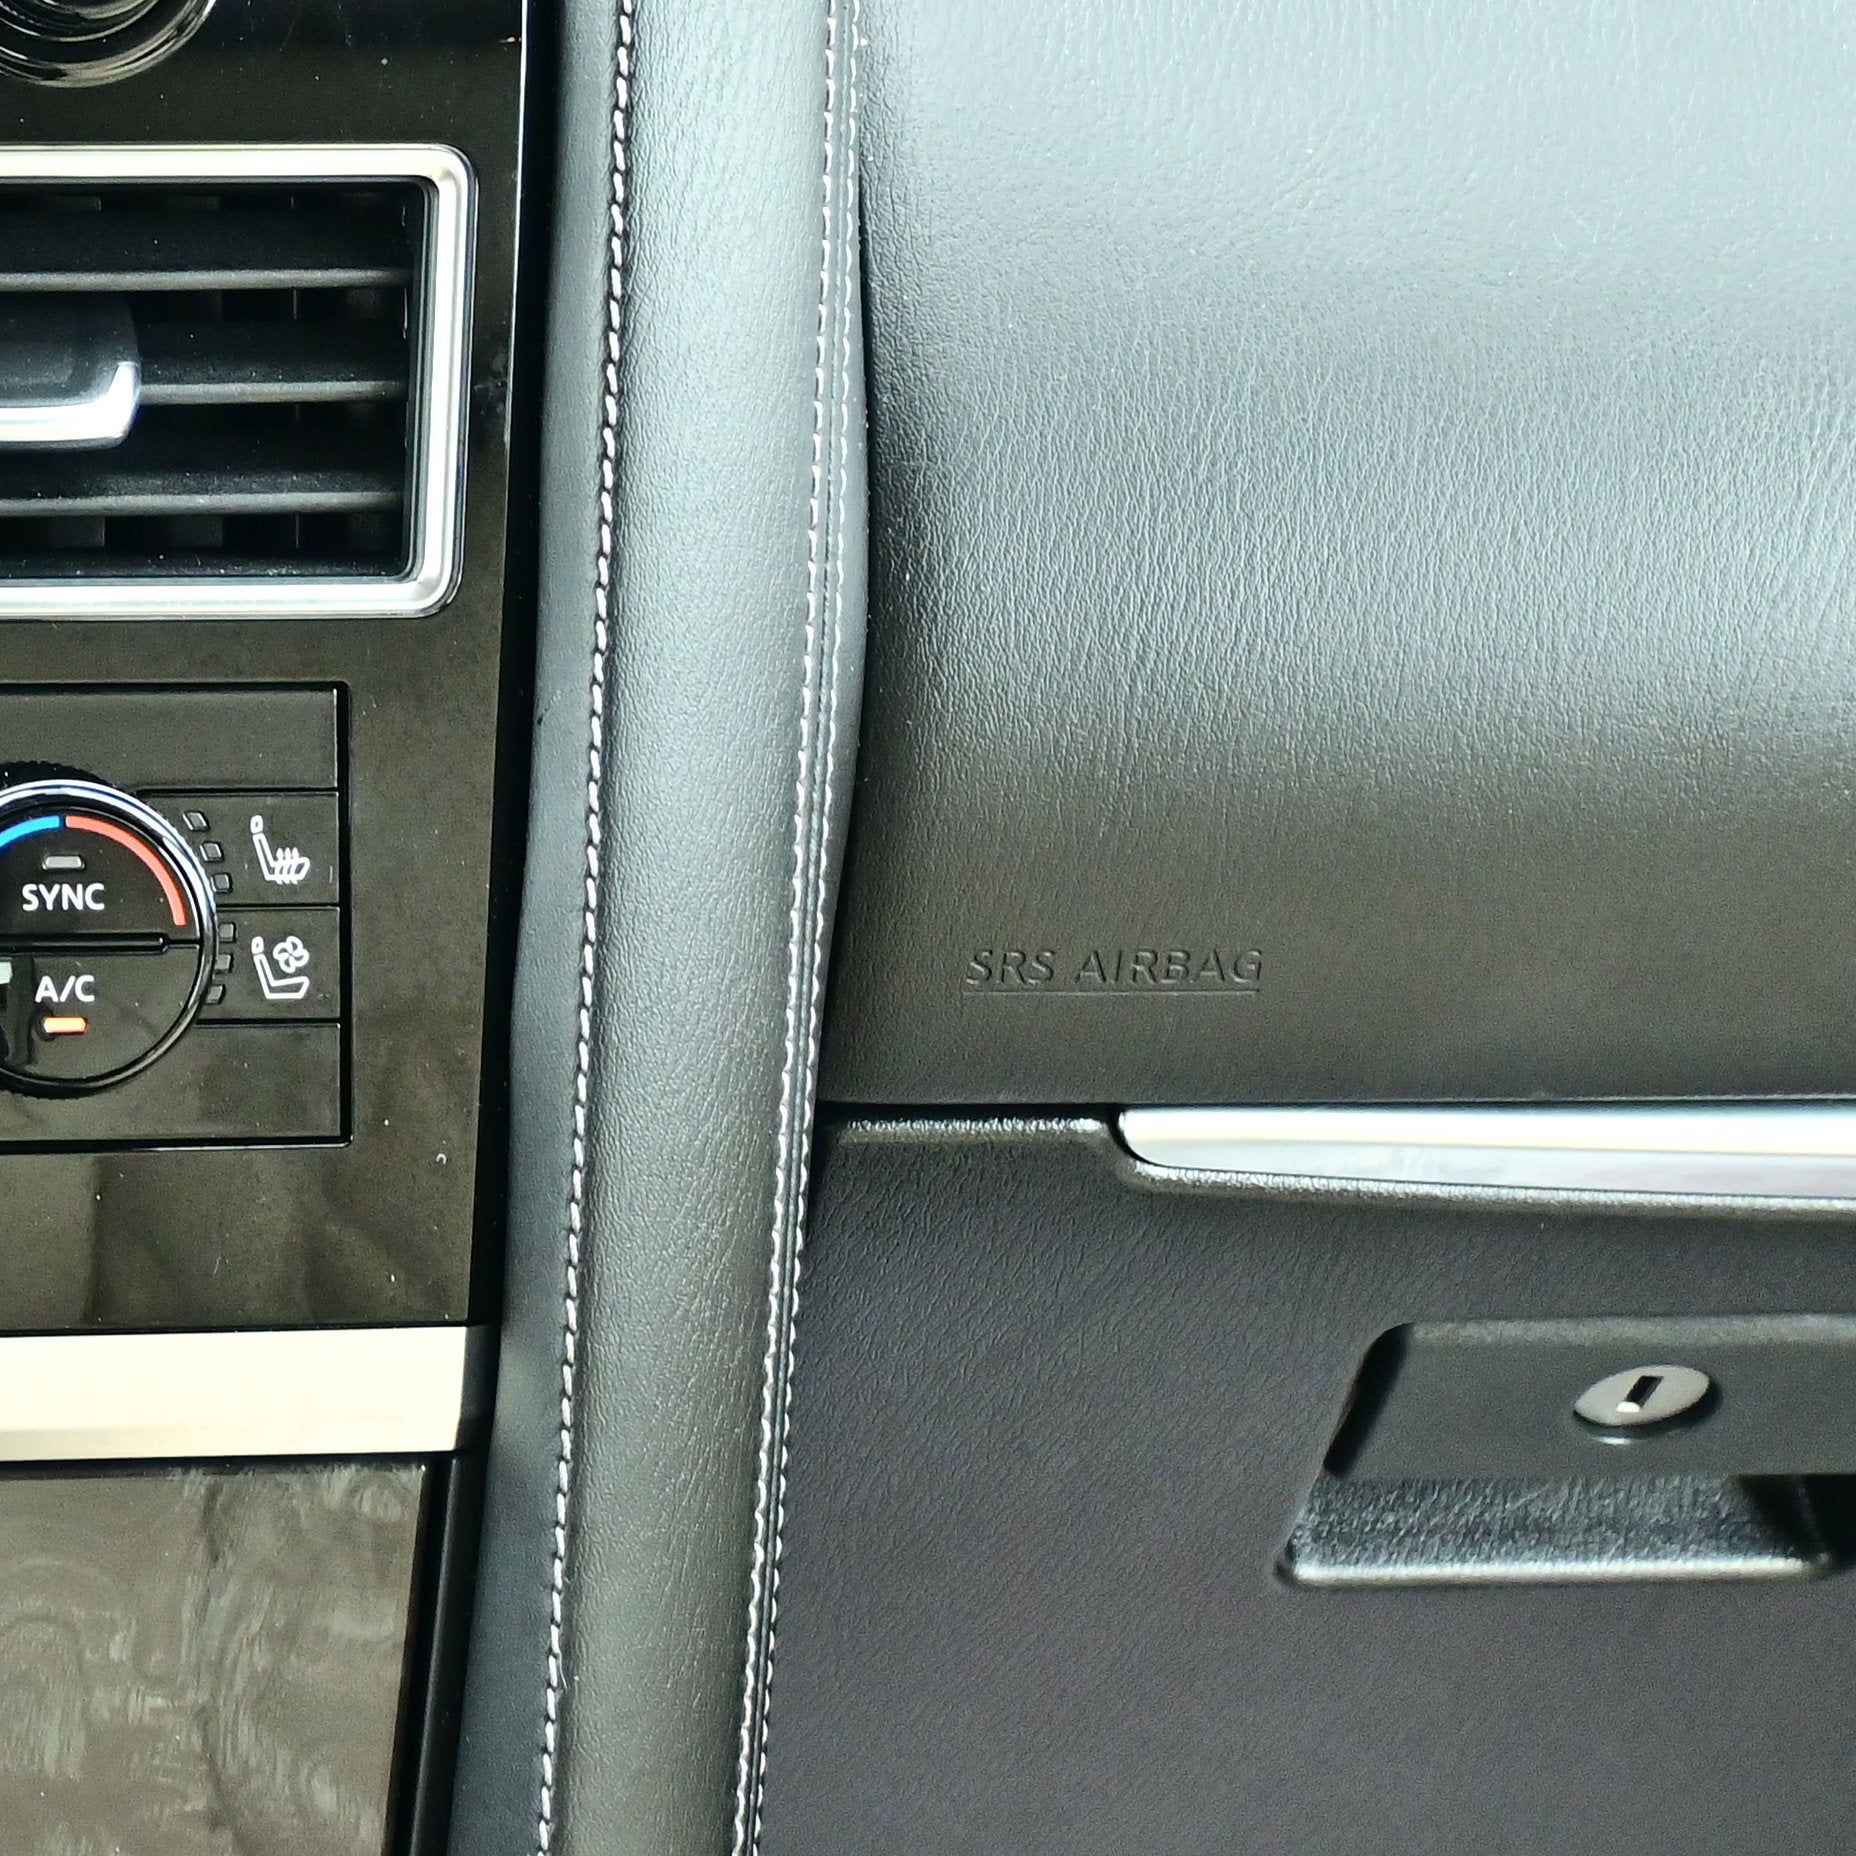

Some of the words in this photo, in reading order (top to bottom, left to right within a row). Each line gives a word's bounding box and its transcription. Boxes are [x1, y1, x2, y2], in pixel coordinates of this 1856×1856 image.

[20, 882, 106, 912] SYNC
[965, 948, 1057, 986] SRS
[1075, 947, 1264, 986] AIRBAG
[34, 975, 96, 1004] A/C
